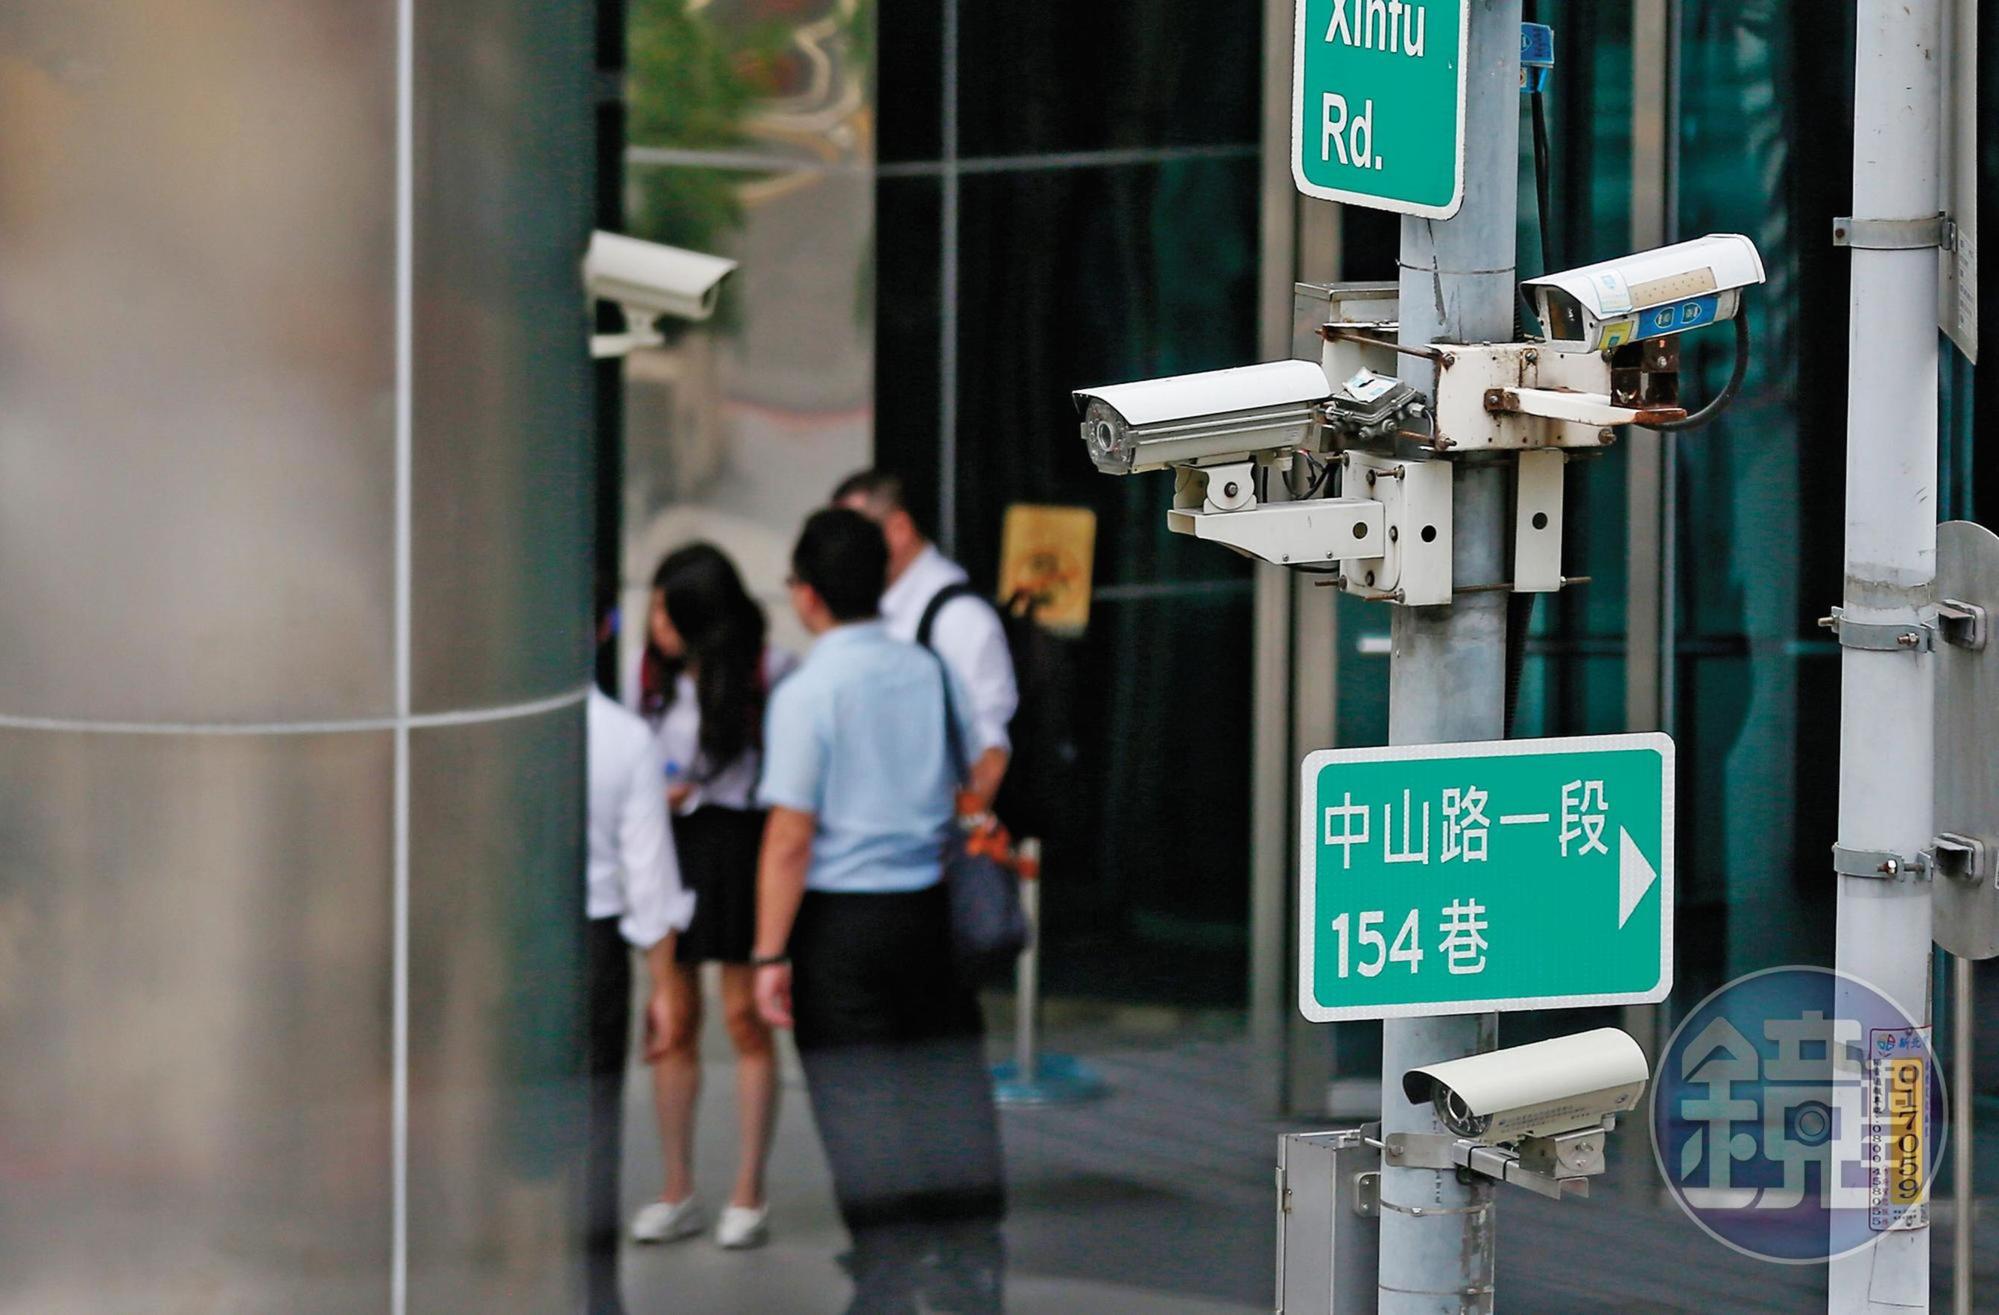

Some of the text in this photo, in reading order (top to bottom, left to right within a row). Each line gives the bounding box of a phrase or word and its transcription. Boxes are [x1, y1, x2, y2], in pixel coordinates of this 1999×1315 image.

[1325, 0, 1425, 57] Xinfu
[1321, 92, 1382, 170] Rd.
[1324, 779, 1609, 869] 中山路一段
[1898, 1064, 1920, 1200] 017059
